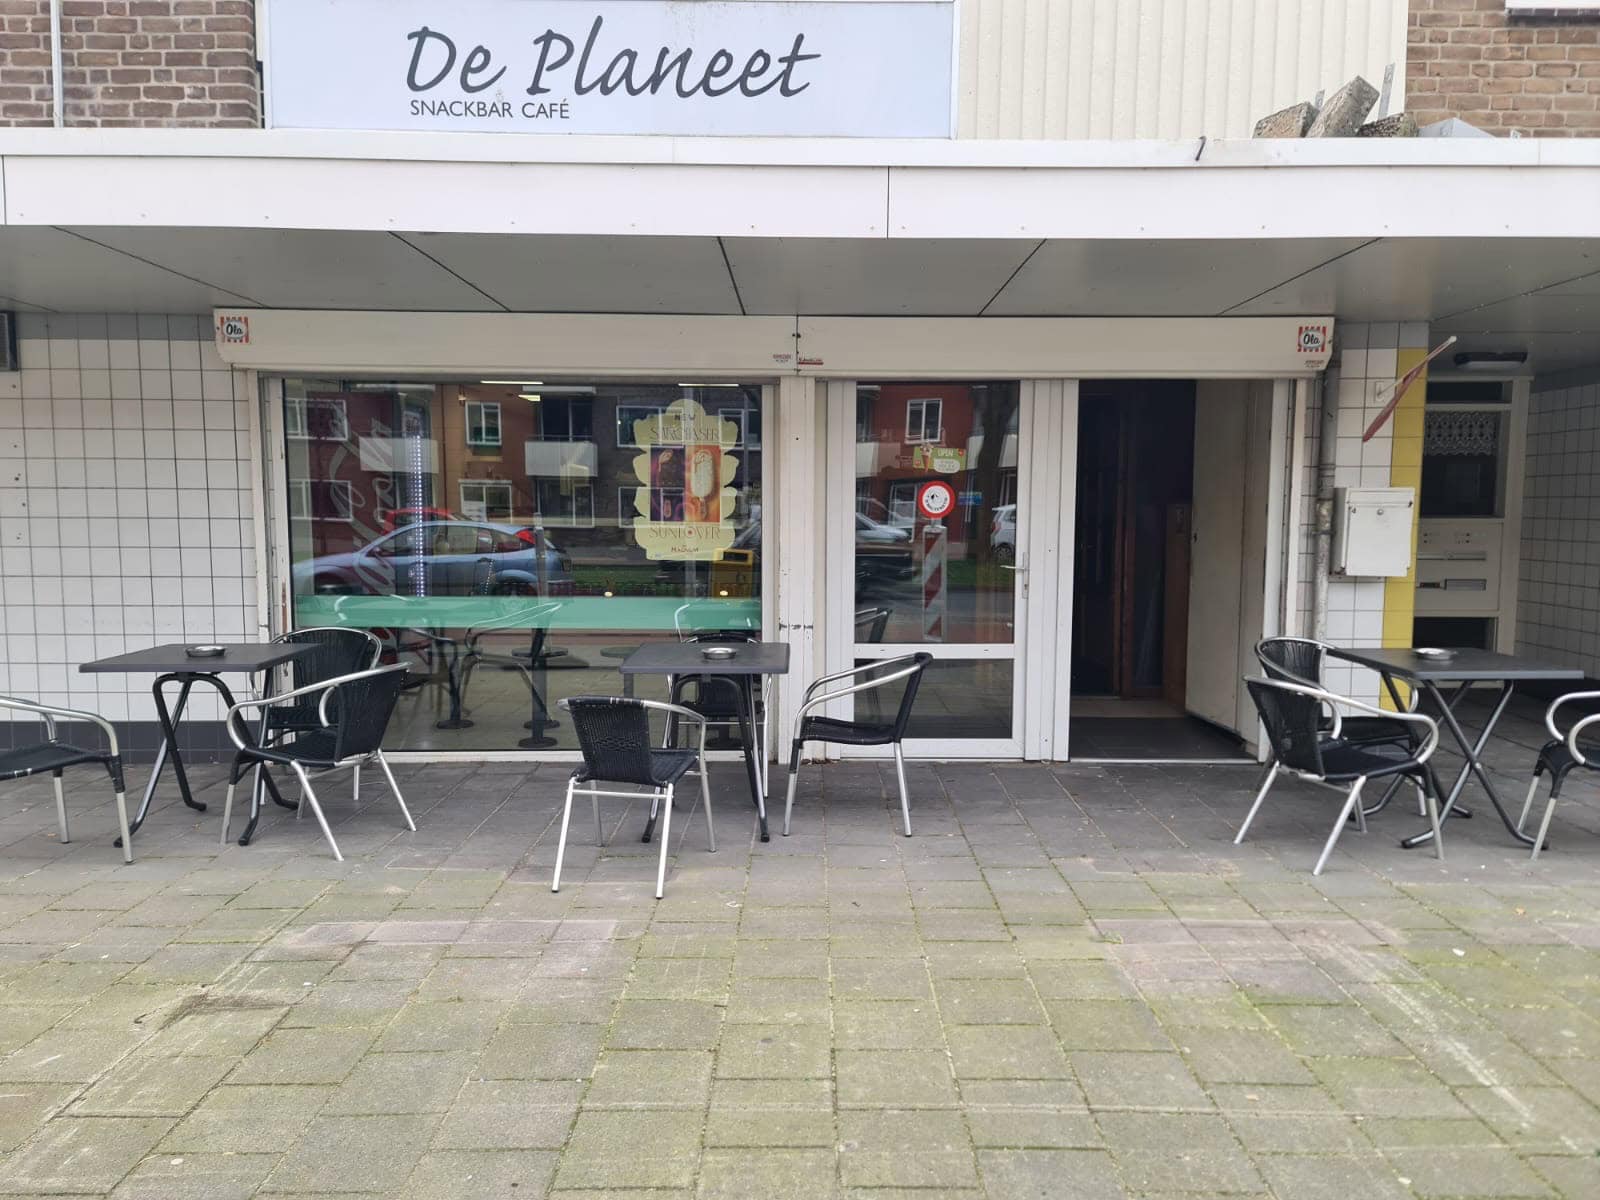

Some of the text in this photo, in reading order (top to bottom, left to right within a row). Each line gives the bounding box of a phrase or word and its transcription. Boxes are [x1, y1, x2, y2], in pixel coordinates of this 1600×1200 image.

[407, 15, 821, 98] De Planeet
[410, 98, 570, 120] SNACKBAR CAFÉ
[226, 323, 244, 336] Ola
[1303, 333, 1321, 345] Ola
